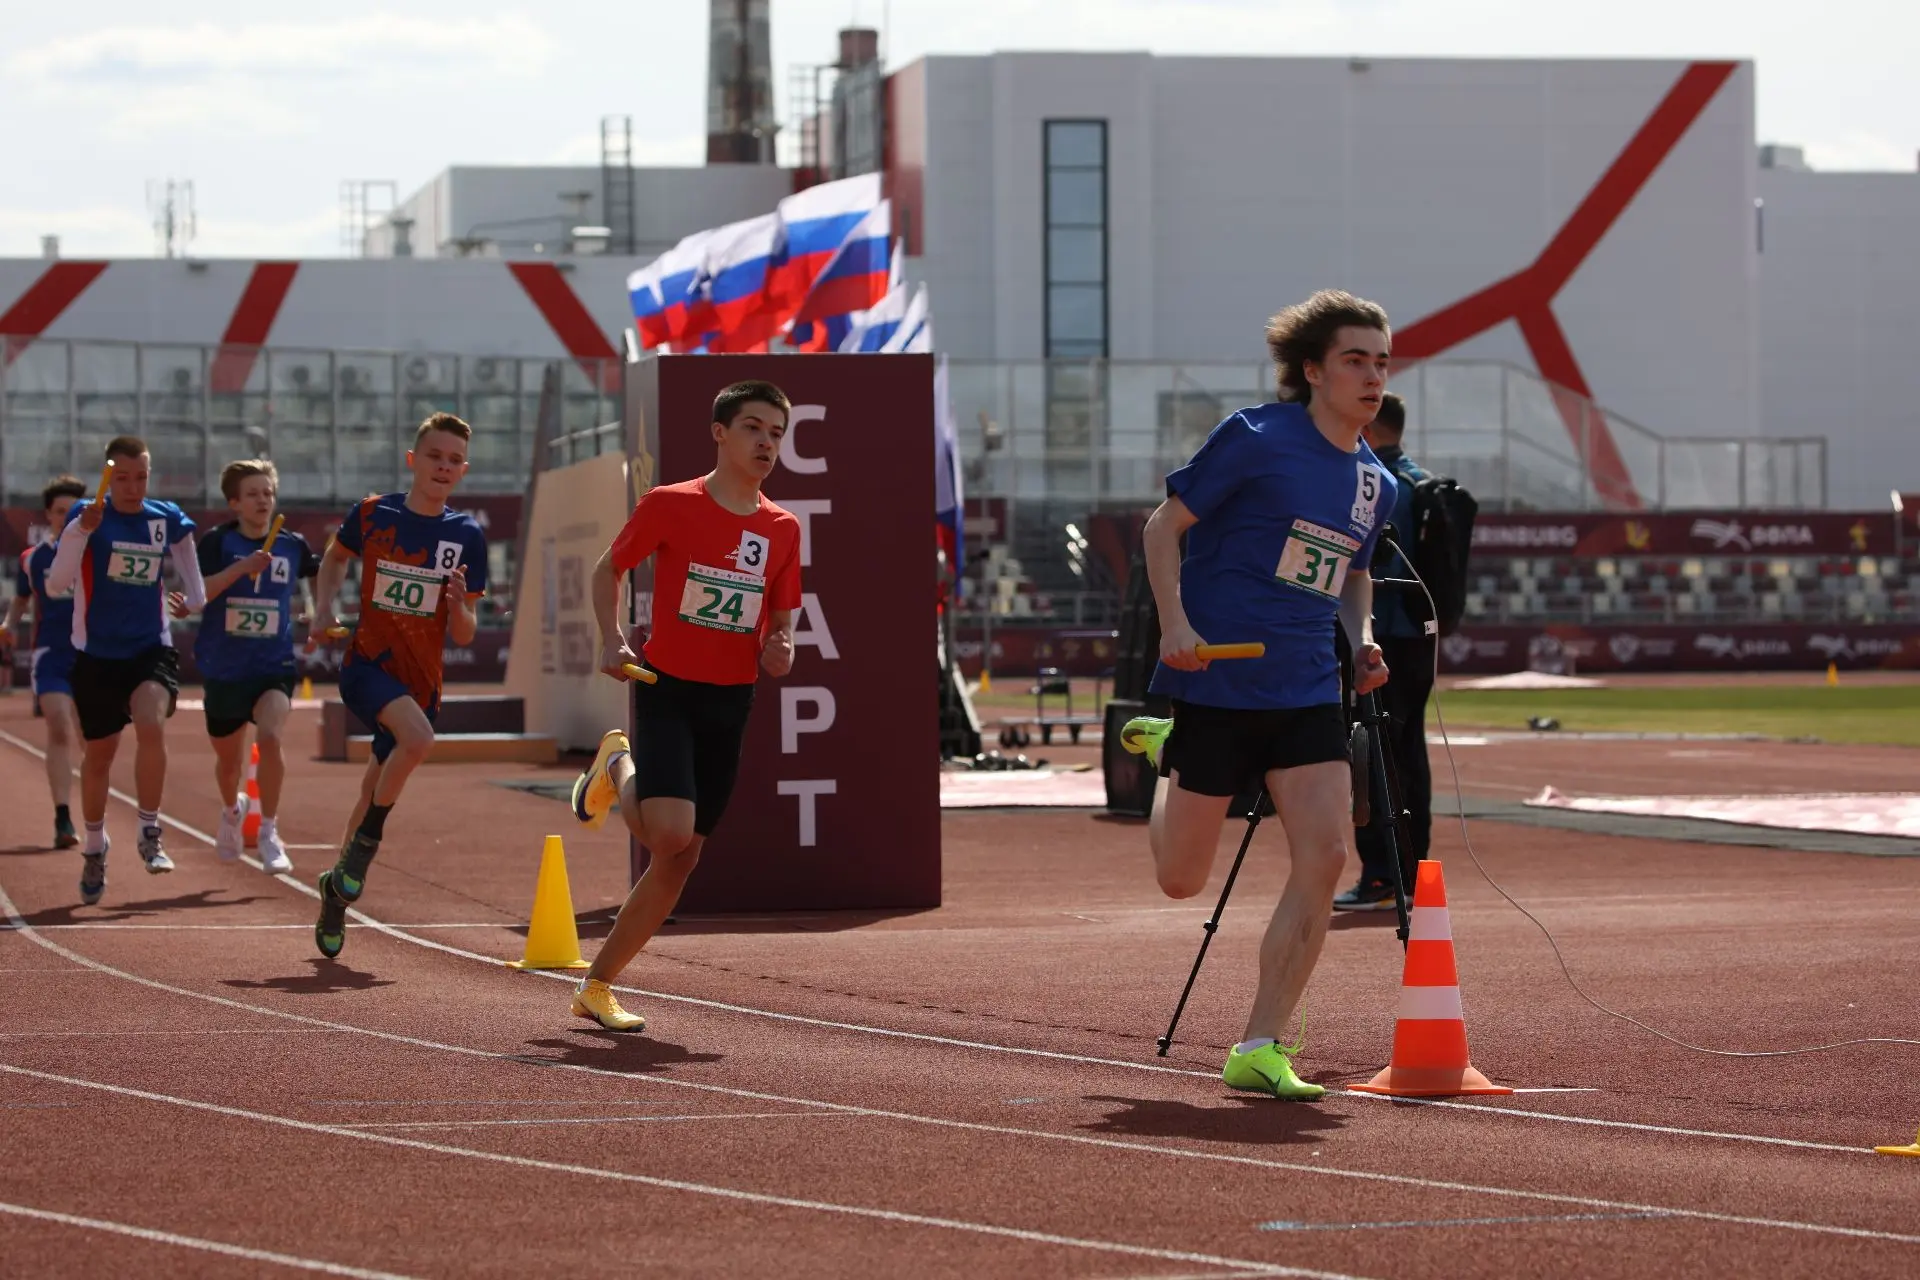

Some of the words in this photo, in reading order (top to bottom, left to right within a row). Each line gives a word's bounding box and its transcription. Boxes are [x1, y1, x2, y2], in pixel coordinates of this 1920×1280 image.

[1362, 470, 1376, 501] 5
[154, 523, 164, 542] 6
[441, 547, 456, 570] 8
[744, 540, 762, 567] 3
[120, 556, 151, 579] 32
[274, 561, 285, 579] 4
[1295, 546, 1340, 591] 31
[384, 580, 425, 609] 40
[696, 586, 744, 624] 24
[236, 610, 269, 632] 29
[776, 404, 841, 848] СТАРТ
